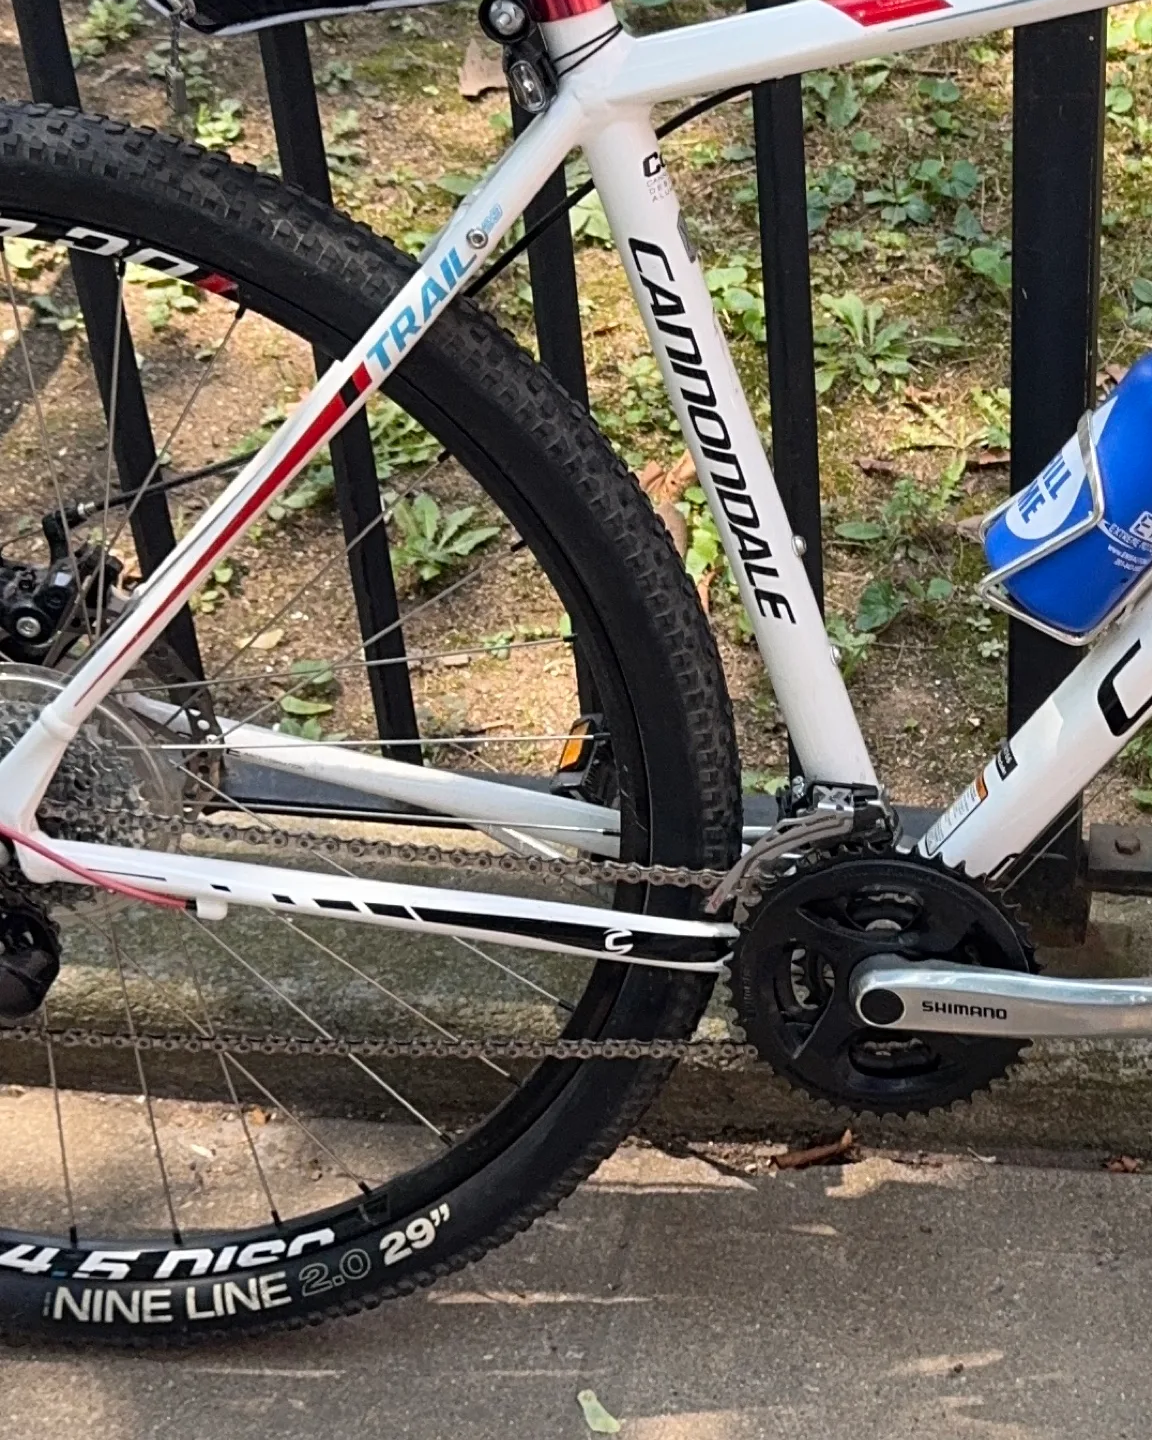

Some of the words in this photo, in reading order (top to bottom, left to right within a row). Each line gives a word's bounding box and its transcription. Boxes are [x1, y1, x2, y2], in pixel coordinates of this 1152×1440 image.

[365, 246, 477, 373] TRAIL
[629, 237, 797, 625] CANNONDALE
[921, 1000, 1008, 1021] SHIMANO
[53, 1285, 173, 1324] NINE
[186, 1270, 291, 1321] LINE
[299, 1247, 372, 1298] 2.0
